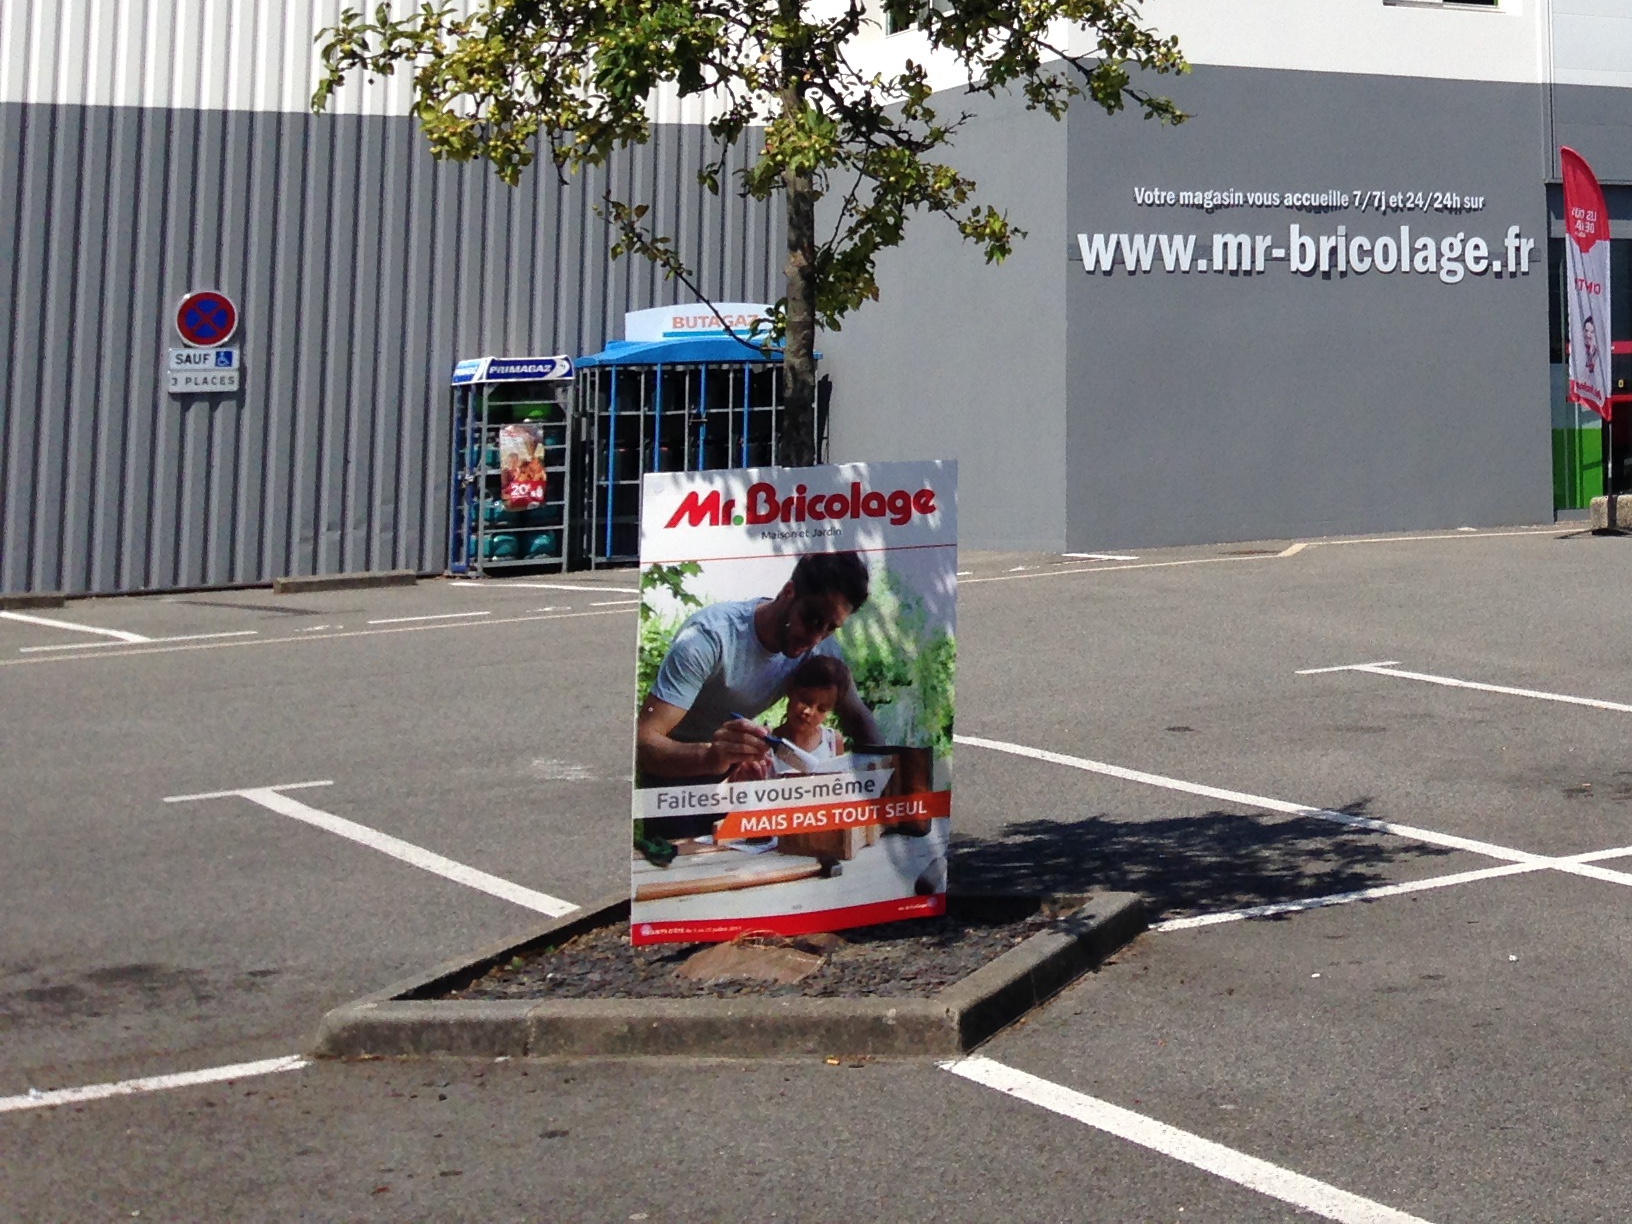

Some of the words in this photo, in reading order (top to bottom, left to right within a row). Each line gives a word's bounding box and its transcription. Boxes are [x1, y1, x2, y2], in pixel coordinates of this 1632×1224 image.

[1134, 187, 1175, 205] Votre
[1179, 187, 1244, 208] magasin
[1246, 193, 1280, 206] vous
[1284, 190, 1349, 207] accueille
[1352, 190, 1386, 211] 7/7j
[1389, 192, 1403, 207] et
[1405, 191, 1461, 211] 24/24h
[1464, 195, 1485, 209] sur
[1077, 223, 1535, 284] www.mr-bricolage.fr
[672, 313, 759, 329] BUTAGAZ
[175, 353, 211, 365] SAUF
[489, 364, 552, 374] PRIMAGAZ
[171, 377, 178, 386] 3
[185, 376, 235, 386] PLACES
[761, 531, 797, 540] Maison
[811, 527, 842, 538] Jardin
[656, 786, 749, 810] Faites-le
[754, 777, 876, 804] vous-même
[740, 815, 788, 833] MAIS
[793, 810, 827, 828] PAS
[832, 804, 880, 824] TOUT
[885, 799, 928, 818] SEUL
